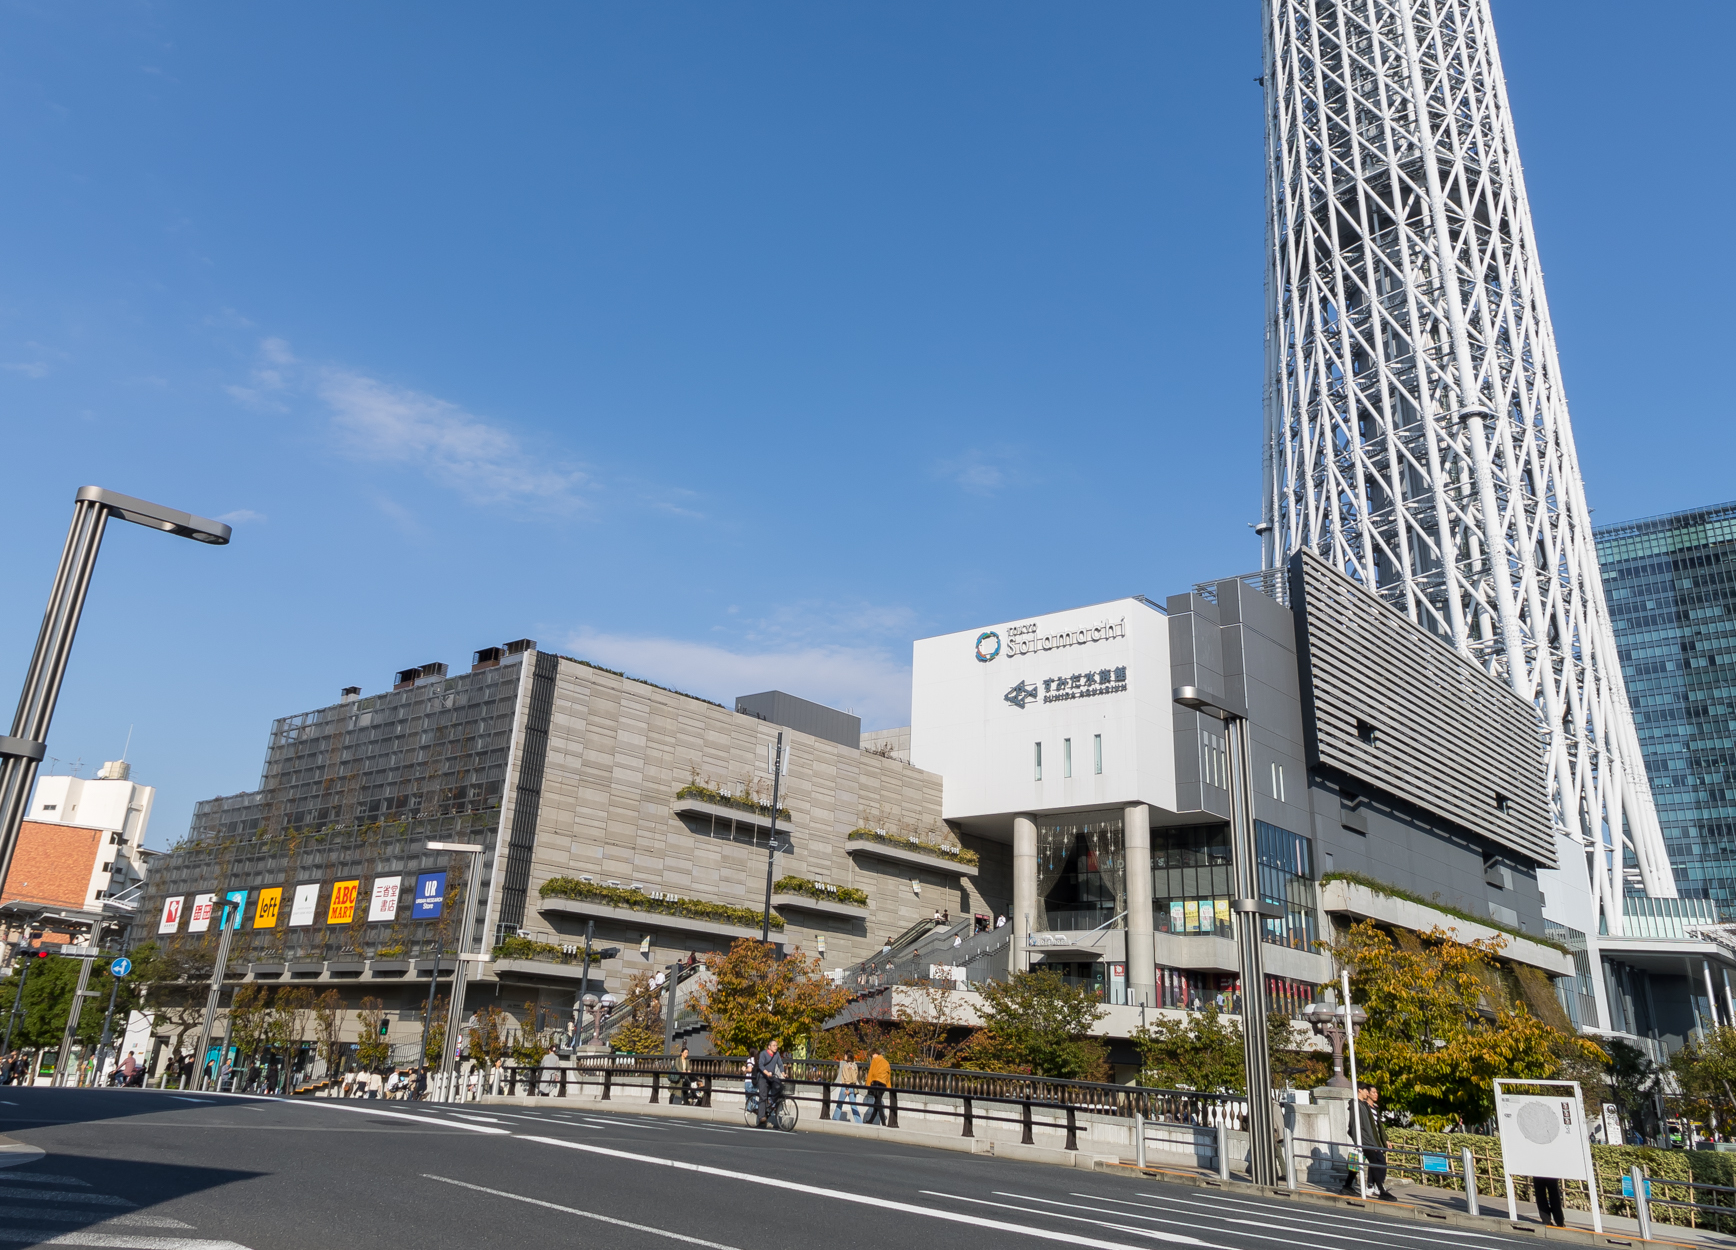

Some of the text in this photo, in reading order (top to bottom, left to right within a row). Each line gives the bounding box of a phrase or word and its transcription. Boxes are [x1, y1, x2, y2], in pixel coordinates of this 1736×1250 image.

[1007, 623, 1038, 636] TOKYO
[1007, 616, 1126, 658] Solamachi
[1042, 665, 1127, 693] すみだ水族館
[1043, 683, 1127, 704] SUMIDA AQUARIUM
[333, 885, 357, 905] ABC
[375, 884, 398, 898] 三省堂
[424, 880, 438, 897] UR
[330, 906, 354, 919] MART
[380, 899, 396, 912] 書店
